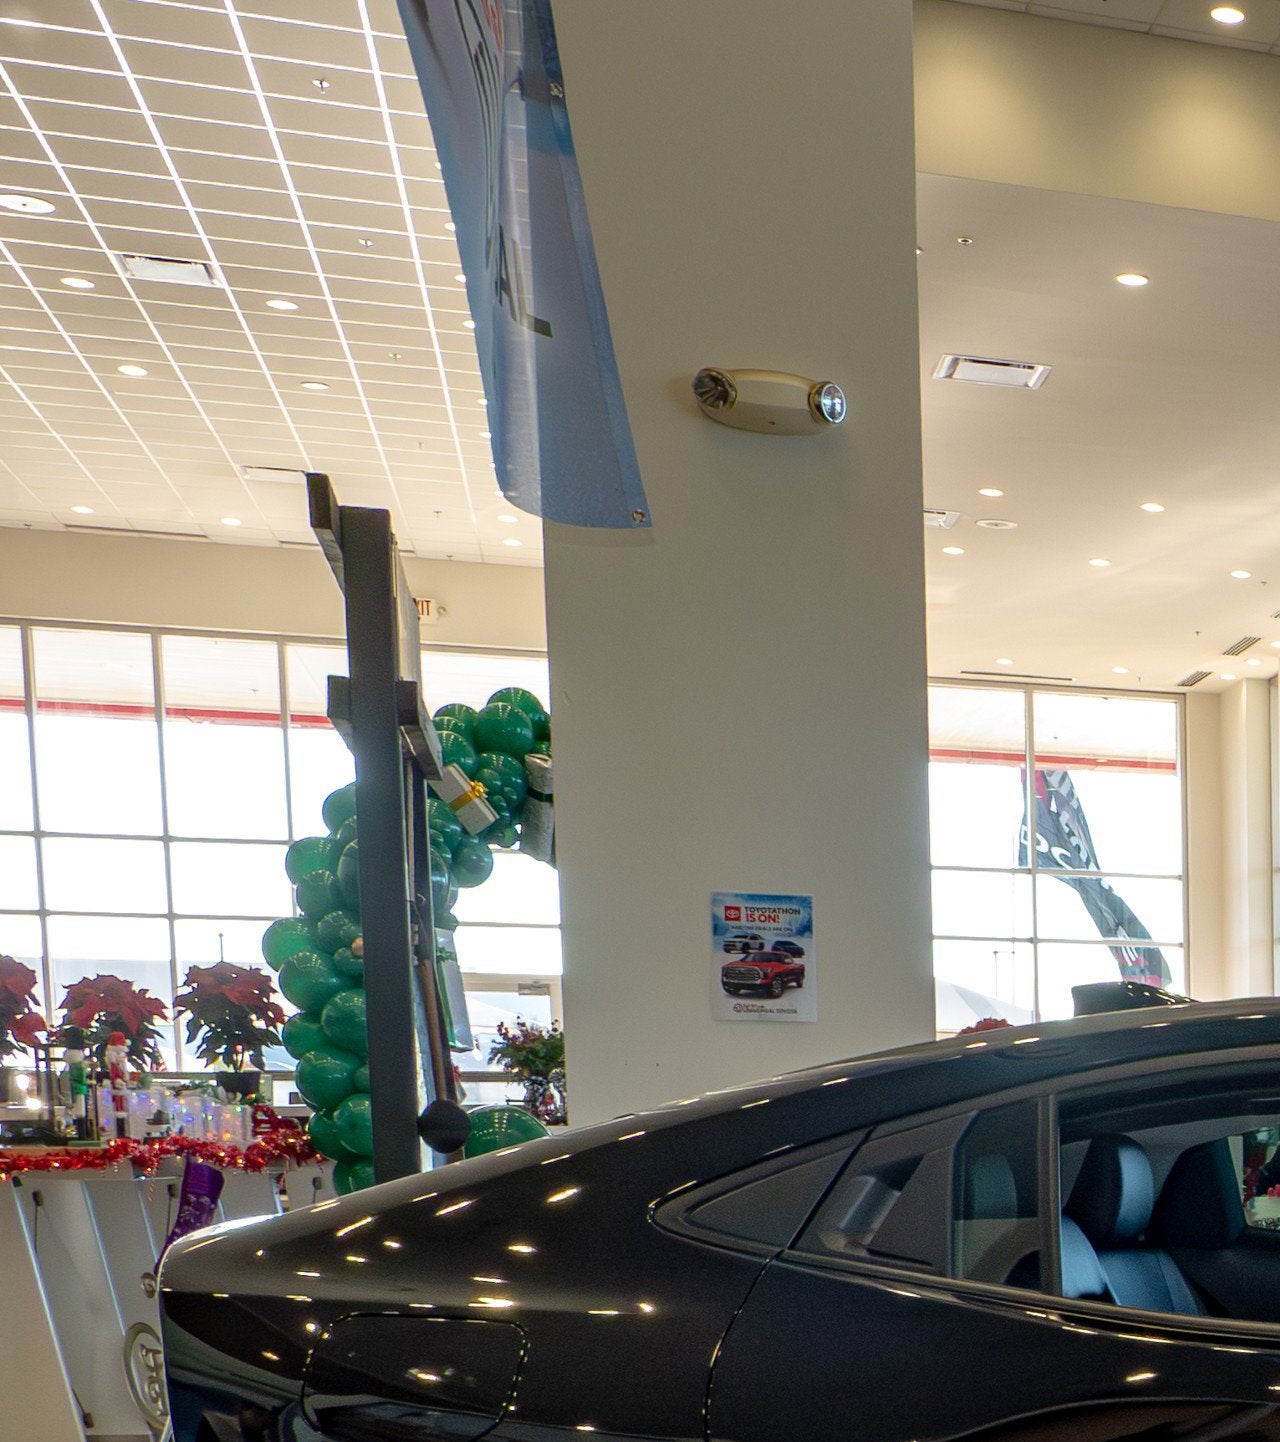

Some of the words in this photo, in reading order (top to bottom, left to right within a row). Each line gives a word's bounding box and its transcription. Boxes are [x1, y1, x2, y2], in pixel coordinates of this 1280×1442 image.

[745, 906, 801, 915] TOYOTATHON
[746, 913, 756, 923] IS
[758, 914, 780, 924] ON!
